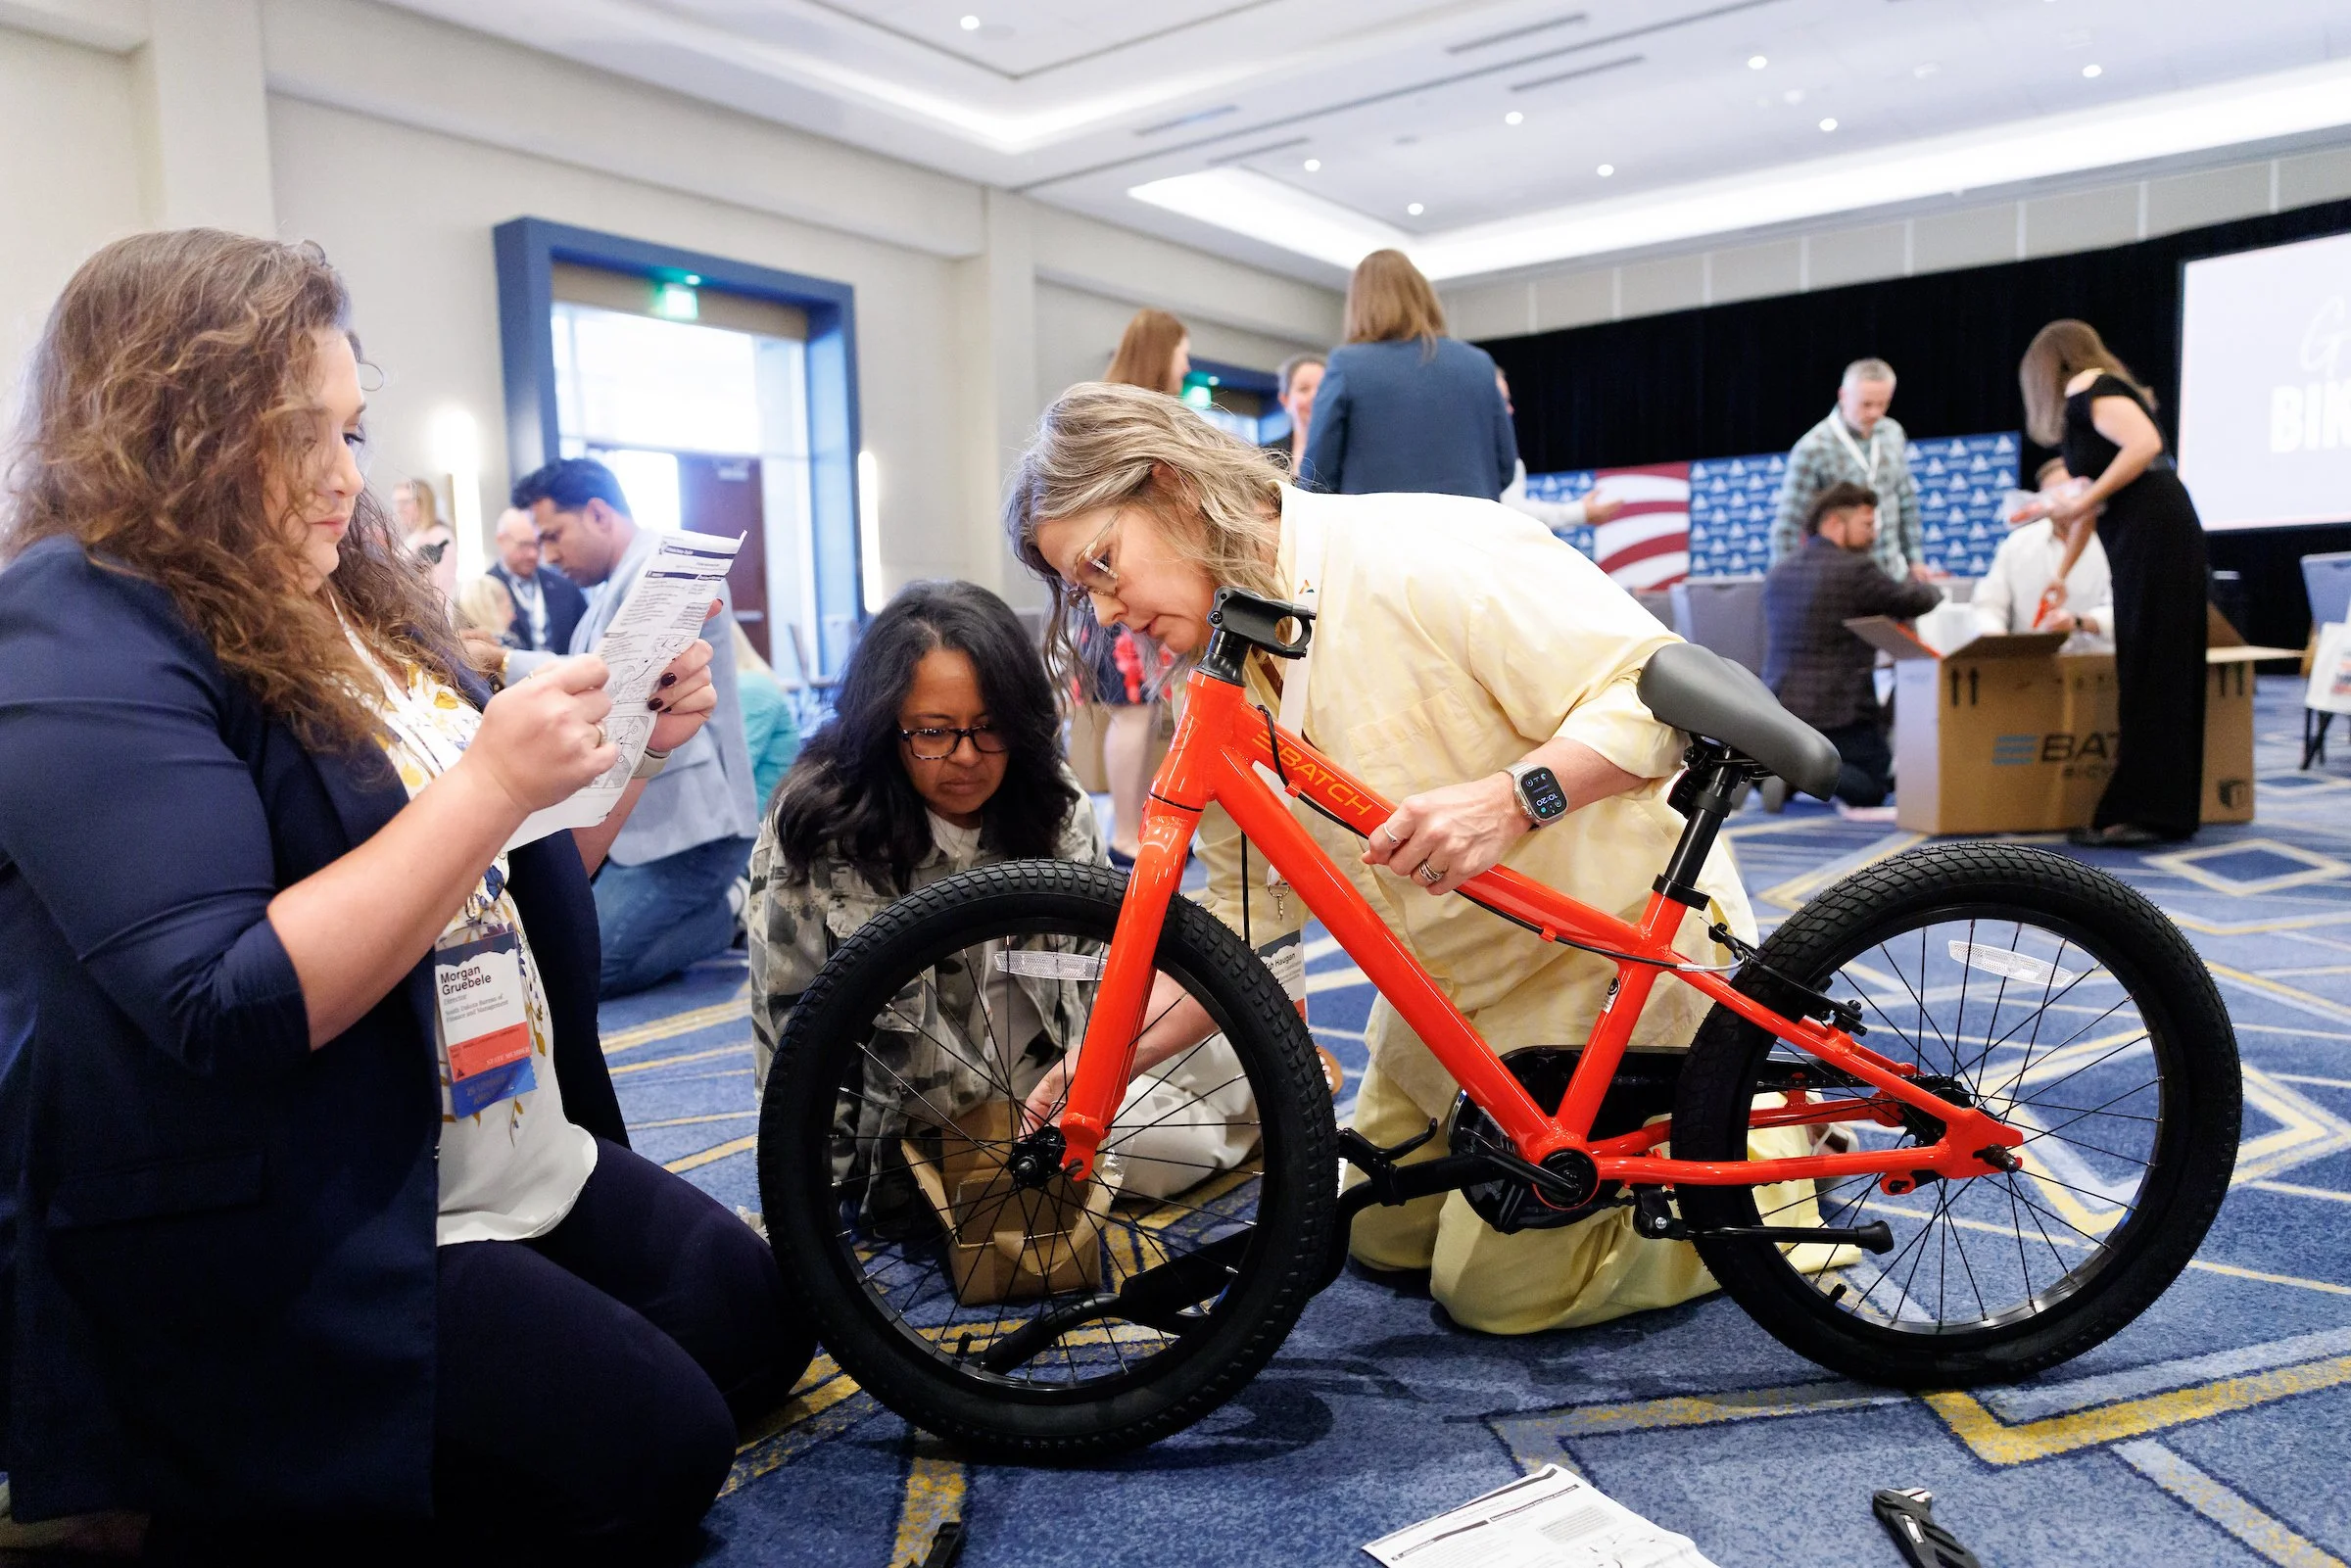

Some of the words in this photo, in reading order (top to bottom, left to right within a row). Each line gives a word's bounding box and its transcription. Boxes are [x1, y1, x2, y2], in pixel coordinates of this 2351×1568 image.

[1536, 793, 1559, 807] 10:20
[1274, 953, 1296, 968] Haugan
[440, 966, 481, 984] Morgan
[442, 974, 492, 996] Gruebele
